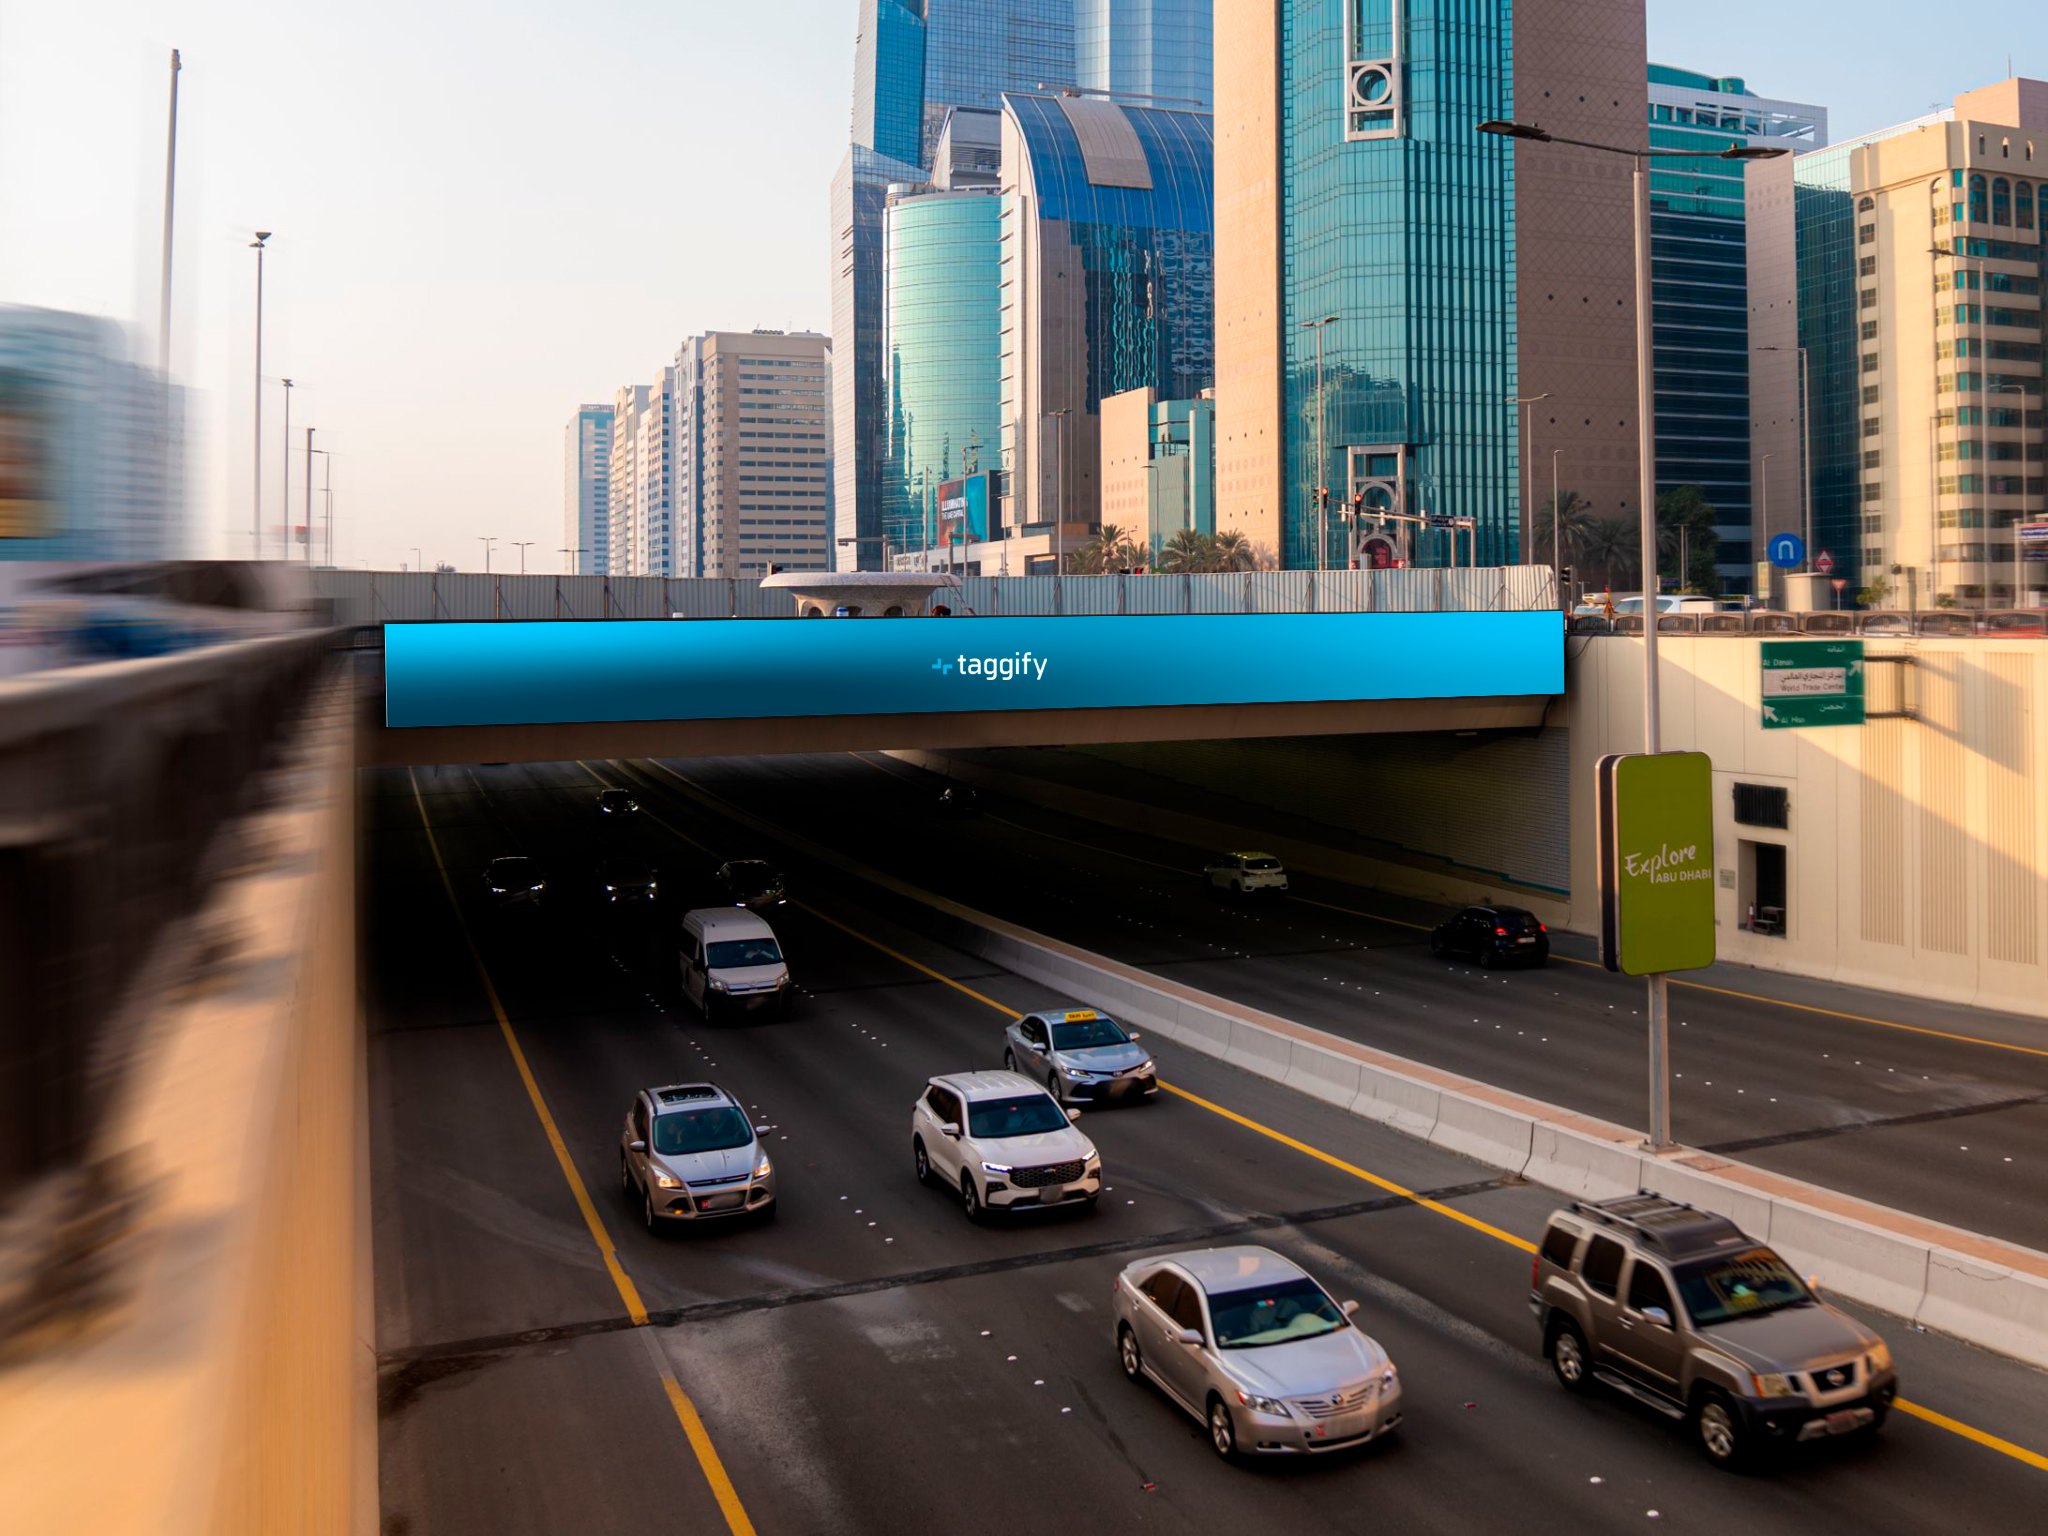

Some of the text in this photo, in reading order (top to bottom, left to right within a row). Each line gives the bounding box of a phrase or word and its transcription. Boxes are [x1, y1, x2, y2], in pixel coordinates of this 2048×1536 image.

[957, 651, 1048, 681] taggify
[1781, 684, 1800, 692] World
[1802, 683, 1821, 691] Trade
[1624, 843, 1696, 884] Explore
[1656, 872, 1678, 884] ABU
[1679, 868, 1712, 881] DHABI
